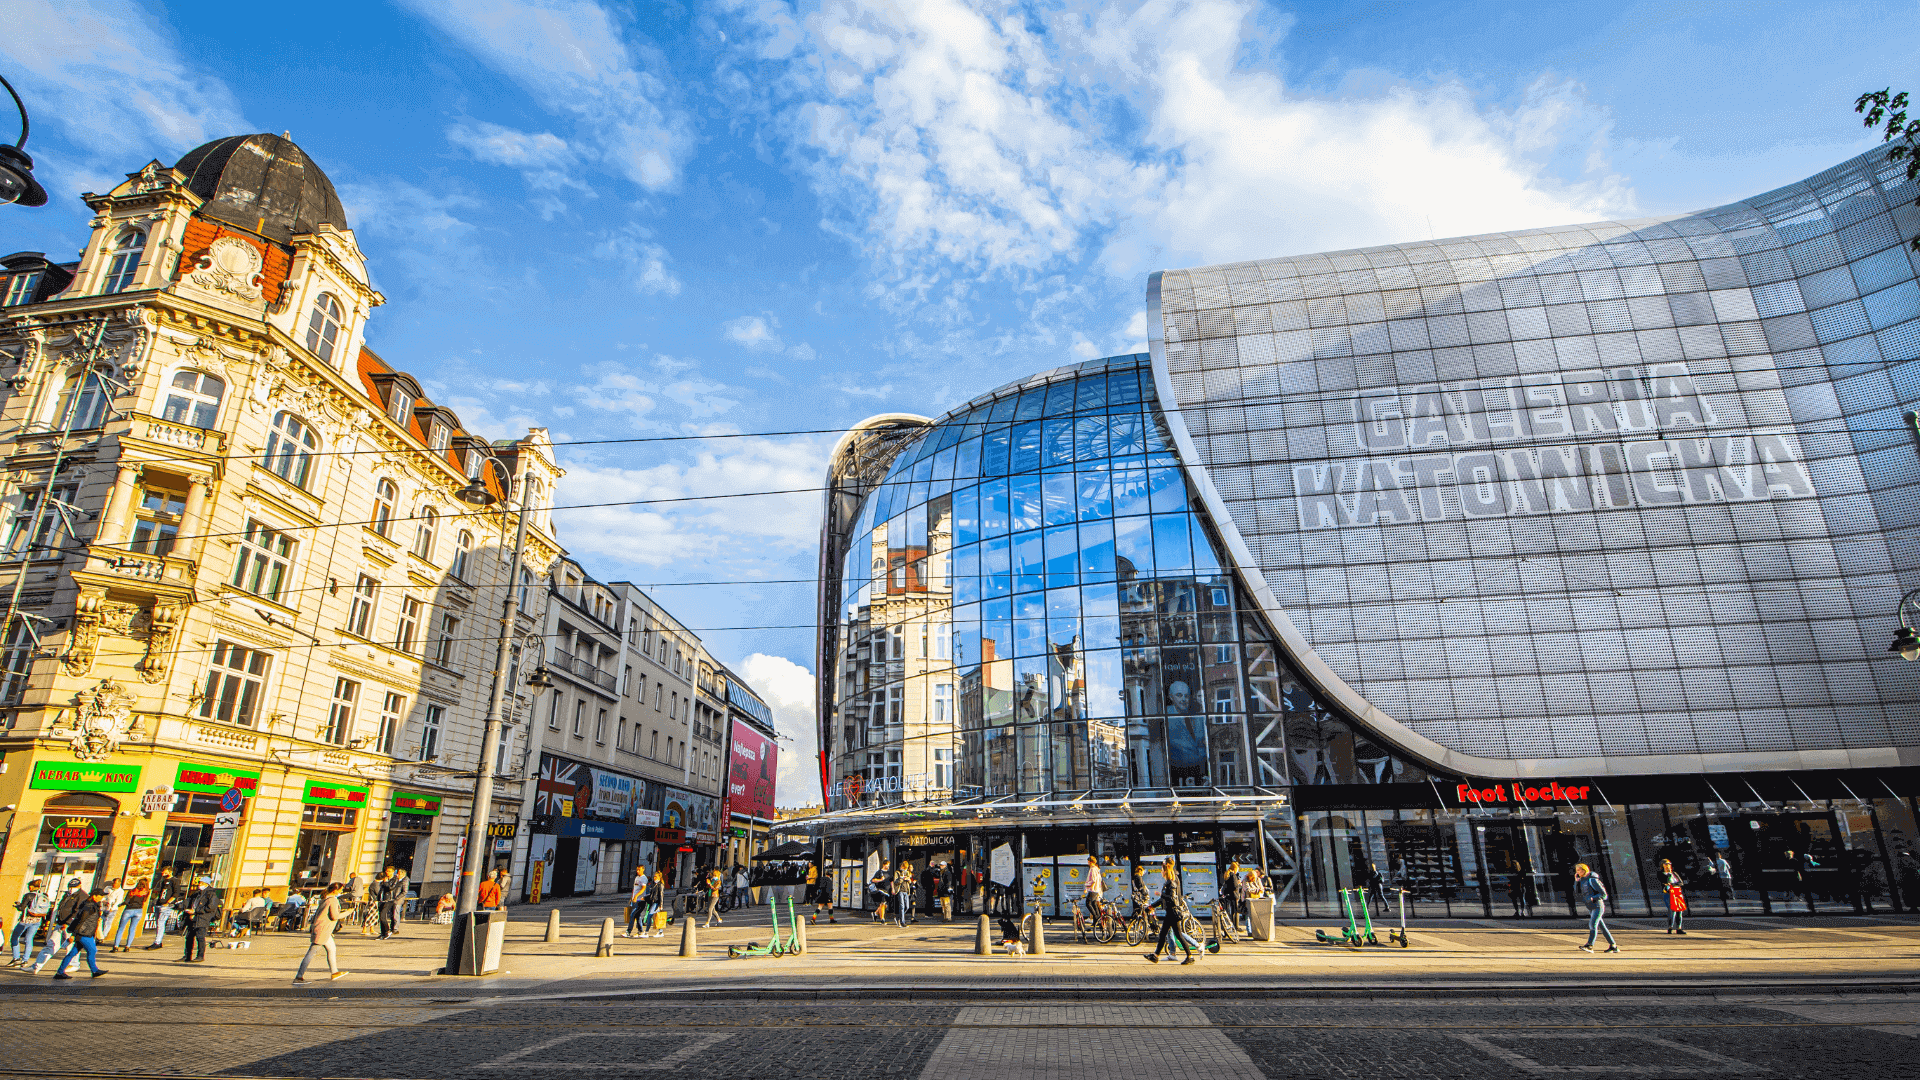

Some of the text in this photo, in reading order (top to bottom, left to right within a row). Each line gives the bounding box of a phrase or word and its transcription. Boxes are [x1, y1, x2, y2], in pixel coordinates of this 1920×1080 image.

[1352, 362, 1716, 452] GALERIA
[1294, 434, 1816, 528] KATOWICKA
[734, 740, 756, 761] Najlepsza
[38, 769, 134, 783] KEBAB KING
[730, 782, 746, 796] ever?
[826, 781, 843, 798] WE
[865, 772, 935, 794] KATOWICE
[1456, 781, 1590, 803] Foot Locker
[146, 794, 173, 803] KEBAB
[146, 803, 167, 811] KING
[55, 827, 96, 838] KEBAB
[490, 824, 513, 836] TOR
[57, 838, 88, 849] KING
[910, 834, 955, 846] KATOWICKA
[531, 861, 543, 903] KANTOR
